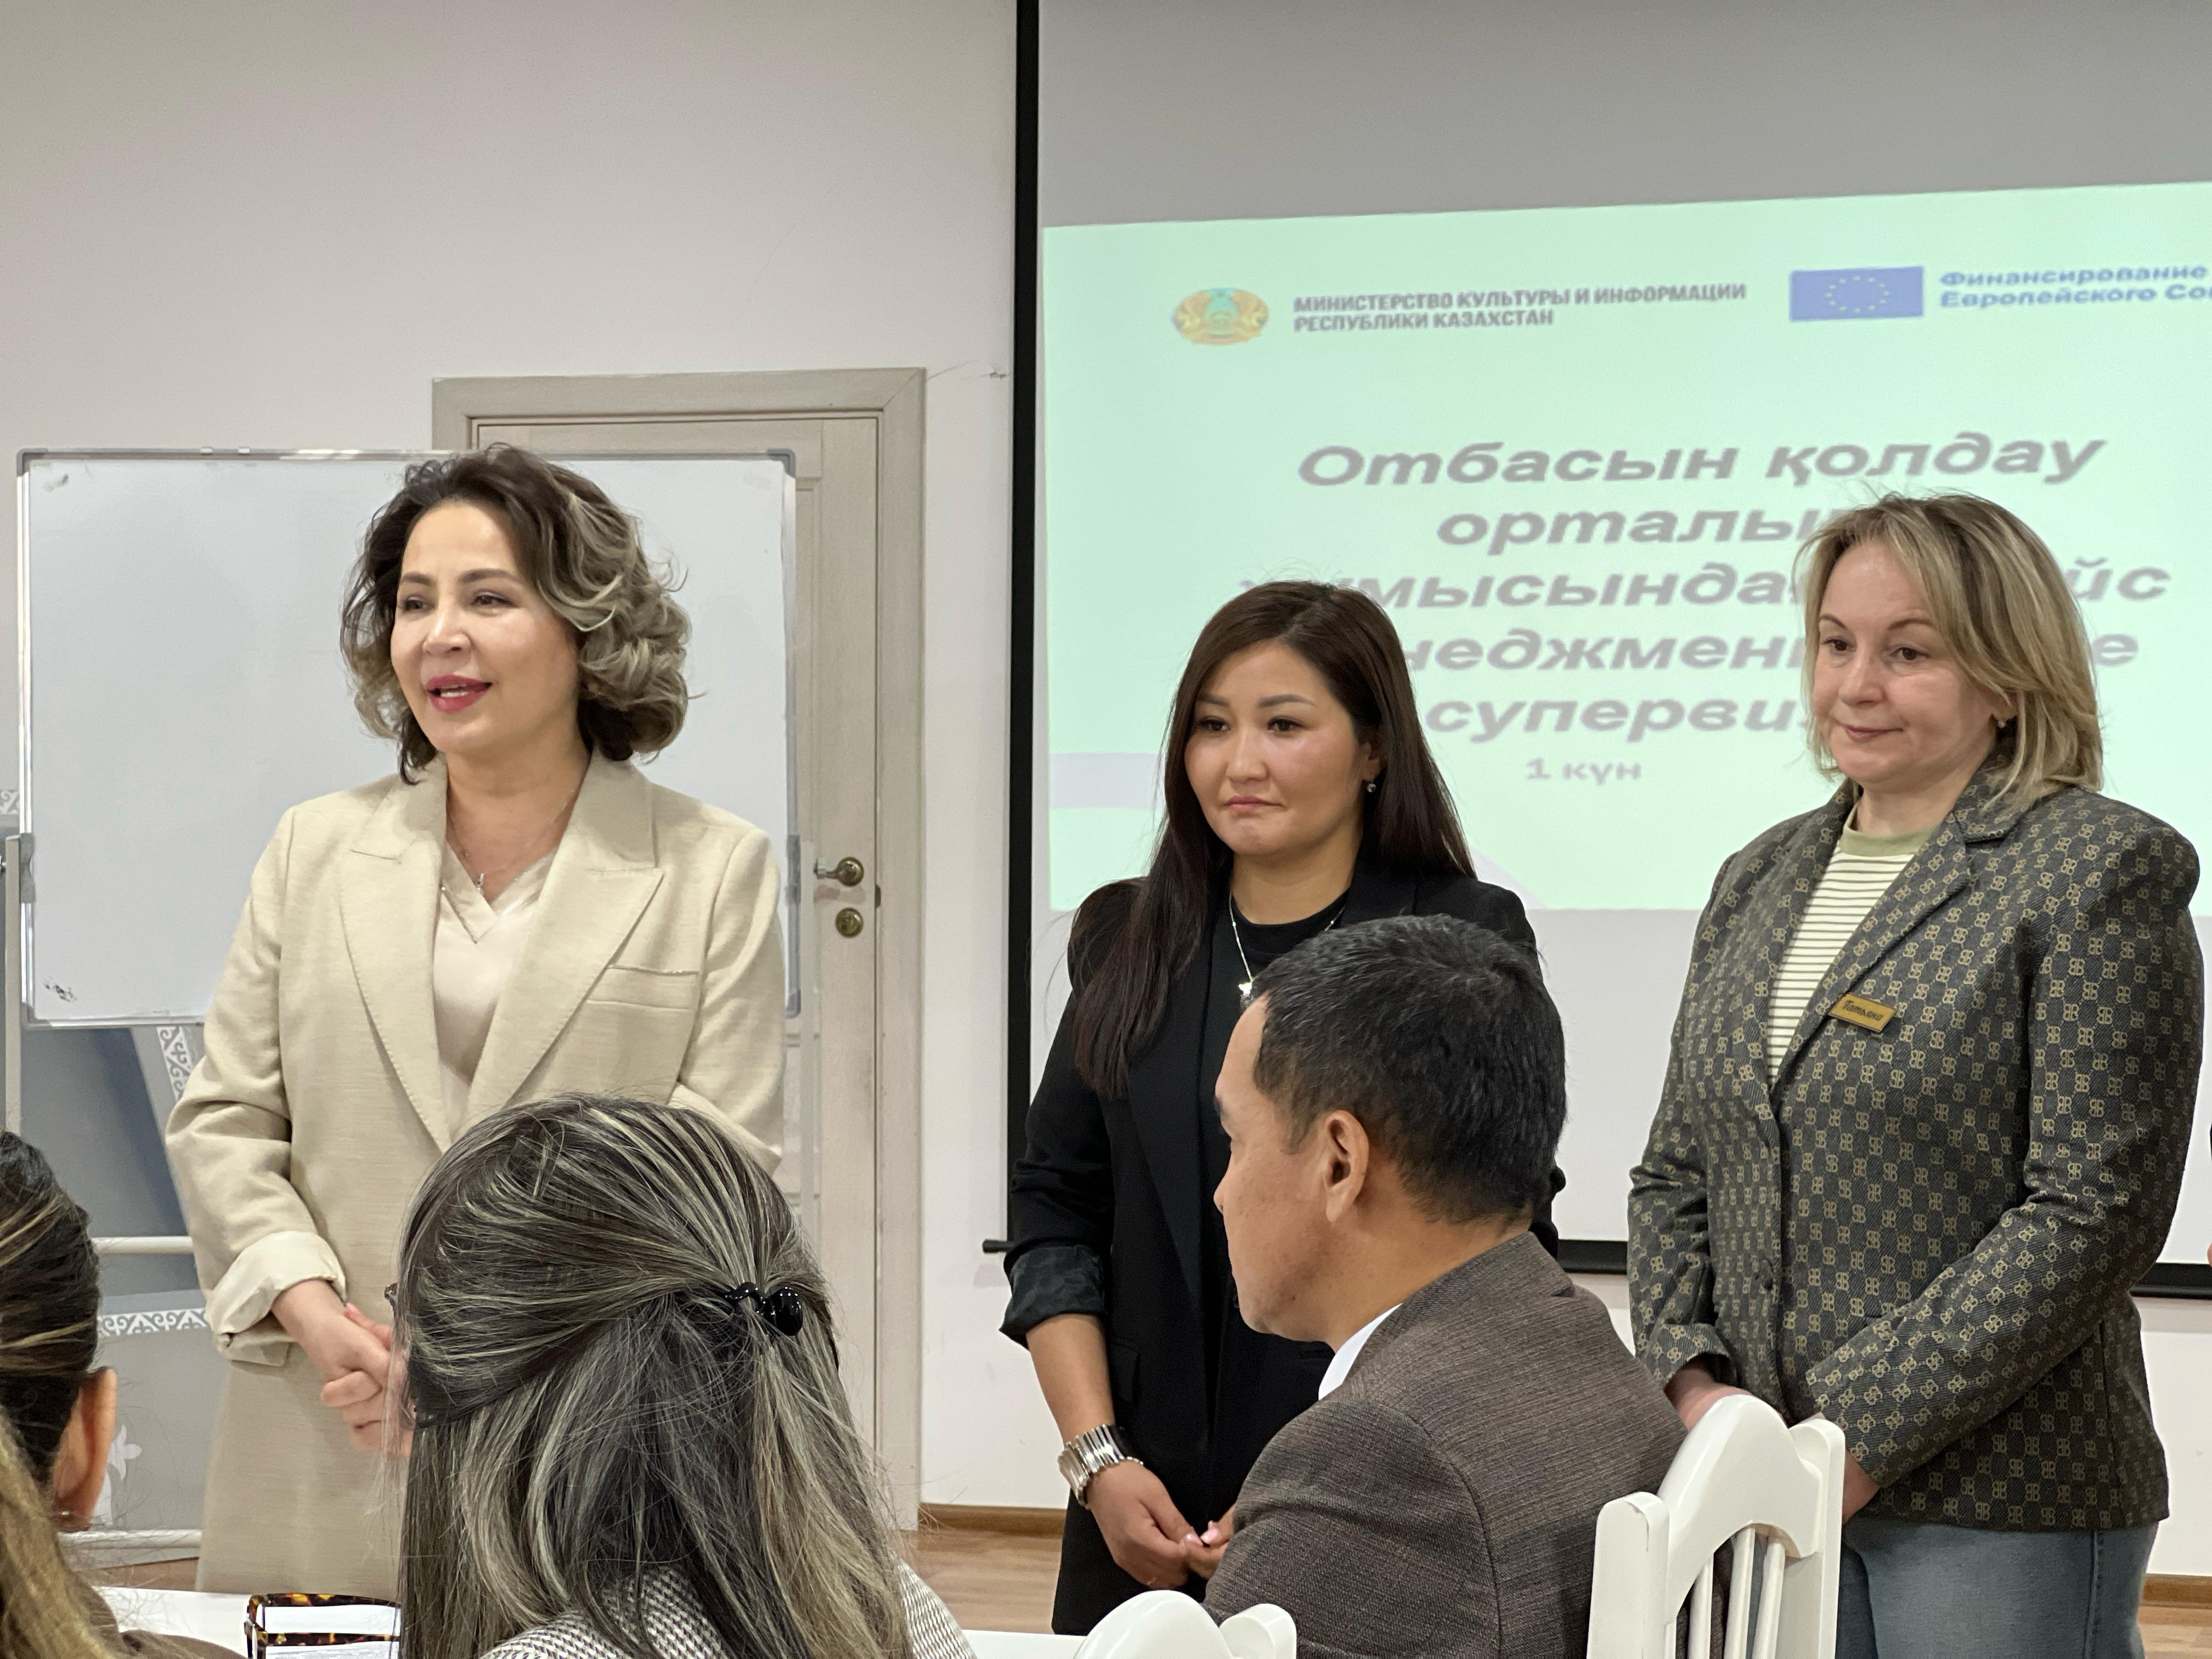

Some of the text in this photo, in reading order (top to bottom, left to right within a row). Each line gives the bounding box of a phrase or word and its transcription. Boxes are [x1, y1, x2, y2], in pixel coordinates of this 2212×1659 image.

[1940, 266, 2208, 286] Финансирование
[1294, 283, 1746, 312] МИНИСТЕРСТВО КУЛЬТУРЫ И ИНФОРМАЦИИ
[1940, 284, 2212, 309] Европейского Со
[1294, 309, 1554, 333] РЕСПУБЛИКИ КАЗАХСТАН
[1297, 431, 2107, 487] Отбасын қолдау
[1436, 509, 1852, 556] орталы
[1426, 697, 1809, 743] суперви
[1526, 757, 1551, 781] 1
